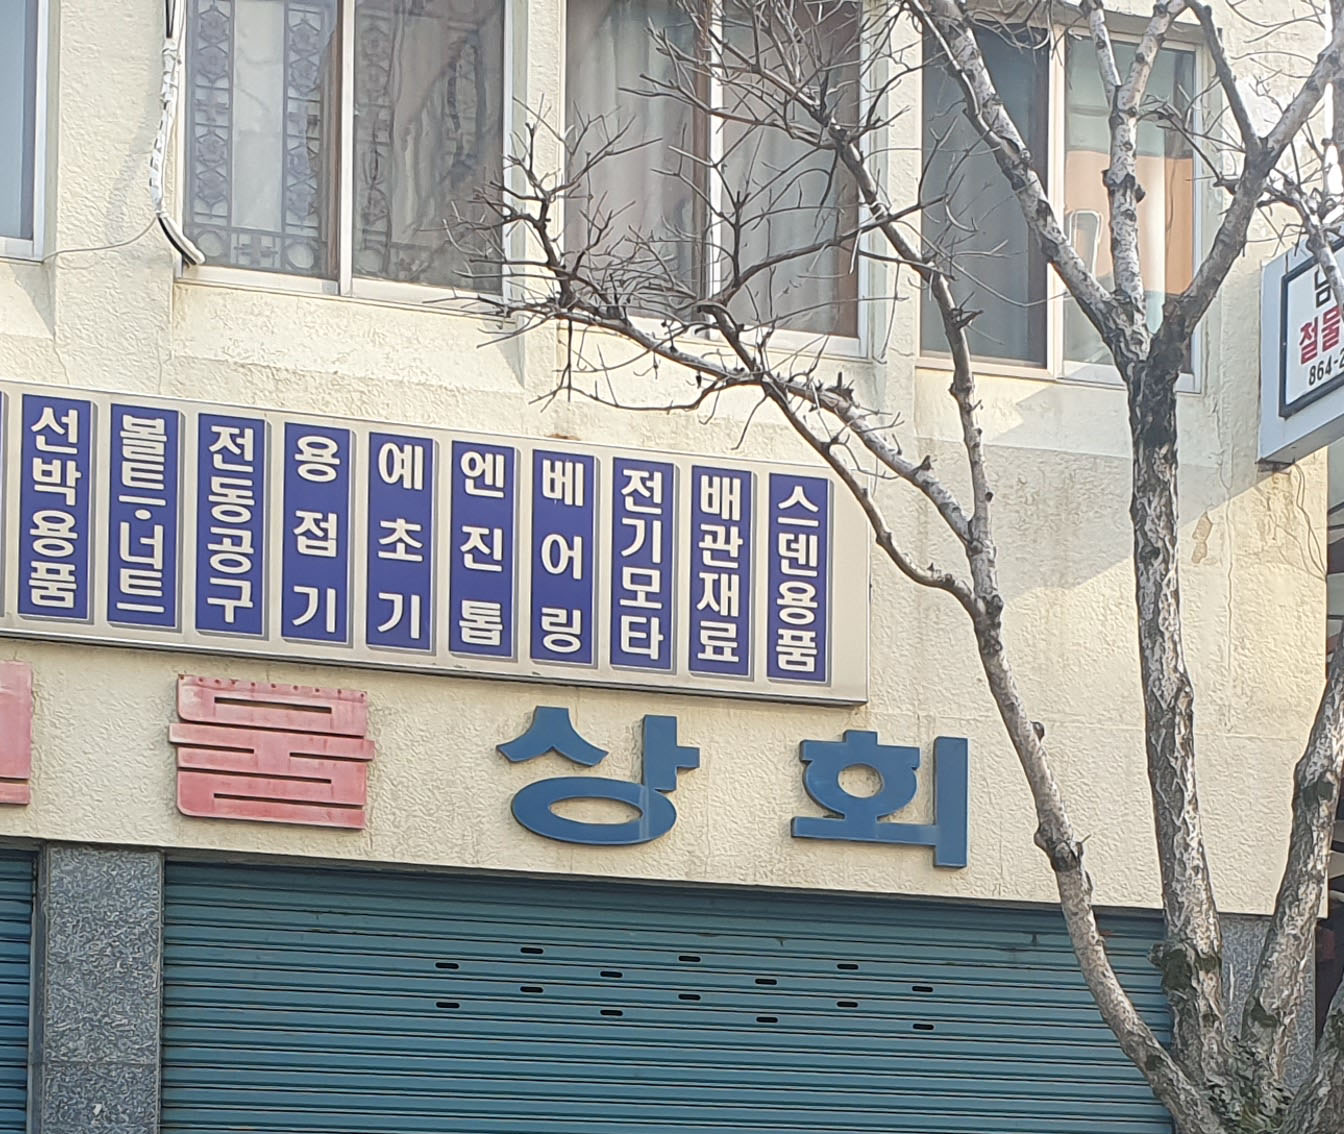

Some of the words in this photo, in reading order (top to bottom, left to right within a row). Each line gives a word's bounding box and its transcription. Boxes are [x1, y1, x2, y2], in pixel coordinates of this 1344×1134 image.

[28, 408, 81, 611] 선박용품
[116, 413, 168, 615] 볼트·너트
[206, 423, 256, 624] 전동공구
[292, 435, 341, 635] 용접기
[376, 441, 425, 641] 예초기
[458, 449, 504, 646] 엔진톱
[541, 456, 586, 654] 베어링
[619, 467, 663, 661] 전기모타
[696, 474, 743, 665] 배관재료
[775, 482, 820, 674] 스덴용품
